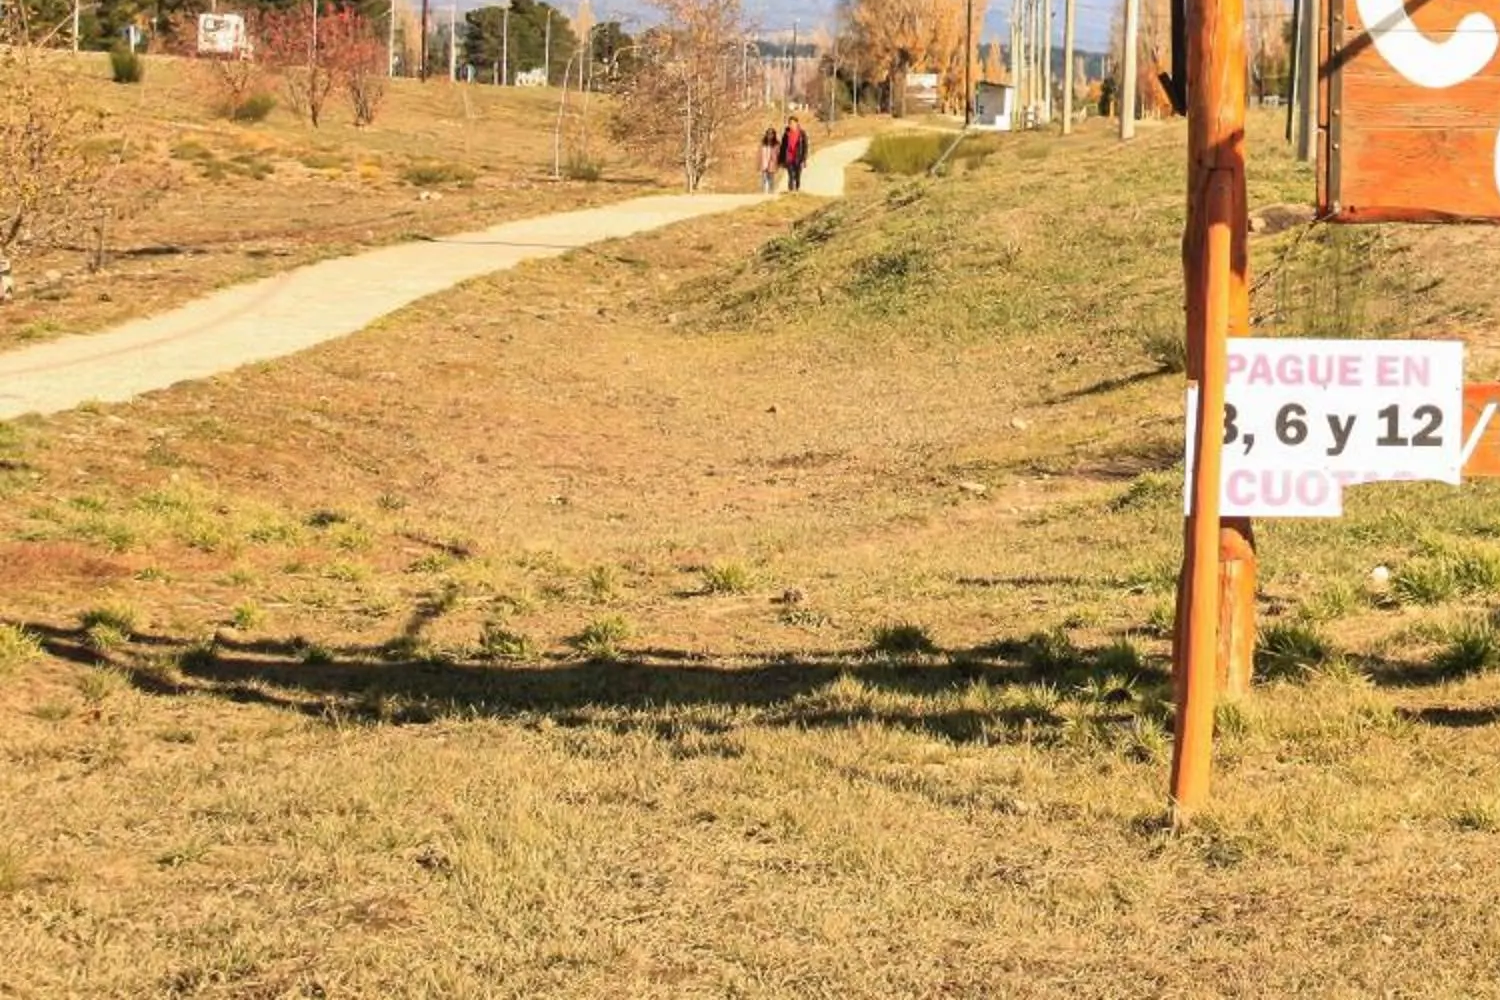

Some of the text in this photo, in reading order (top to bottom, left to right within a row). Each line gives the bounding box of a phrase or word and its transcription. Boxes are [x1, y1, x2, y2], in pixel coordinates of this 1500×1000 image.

[1225, 353, 1430, 387] PAGUE EN
[1275, 402, 1309, 447] 6
[1325, 413, 1357, 457] y
[1376, 403, 1444, 447] 12
